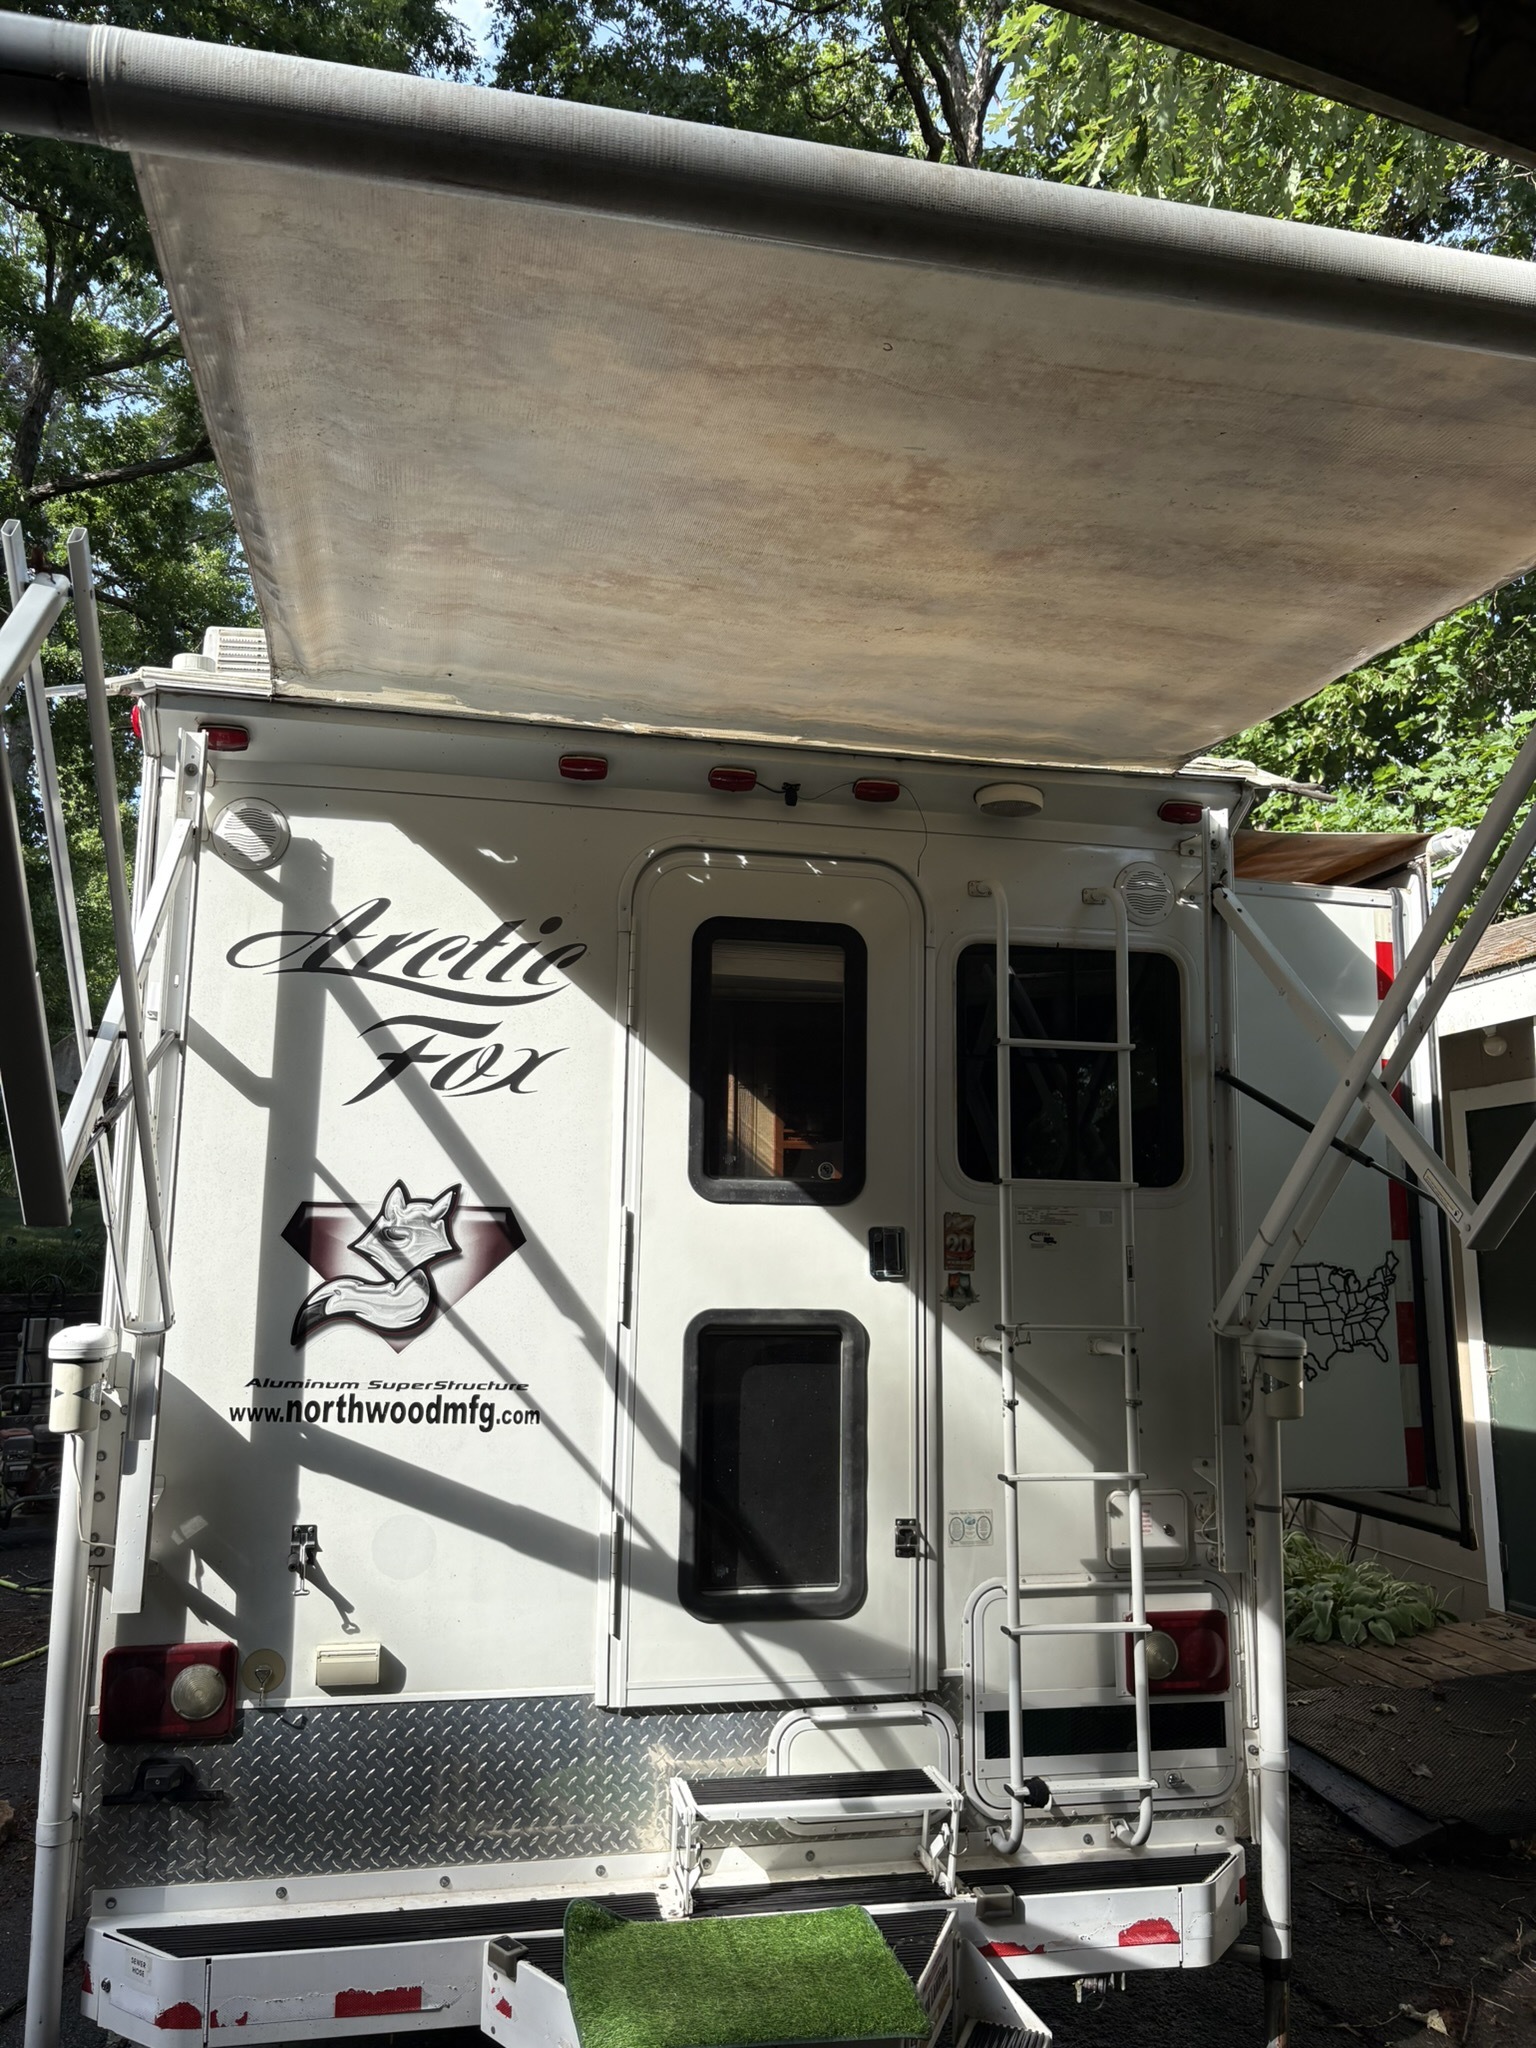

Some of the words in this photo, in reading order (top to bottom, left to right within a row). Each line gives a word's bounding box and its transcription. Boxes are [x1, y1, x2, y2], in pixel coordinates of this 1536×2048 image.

[226, 898, 588, 998] Arctic
[342, 1015, 571, 1106] Fox
[244, 1378, 360, 1390] Aluminum
[367, 1380, 529, 1392] SuperStructure
[229, 1393, 541, 1433] www.northwoodmfg.com
[131, 1957, 146, 1968] SEWER
[132, 1967, 144, 1977] HOSE
